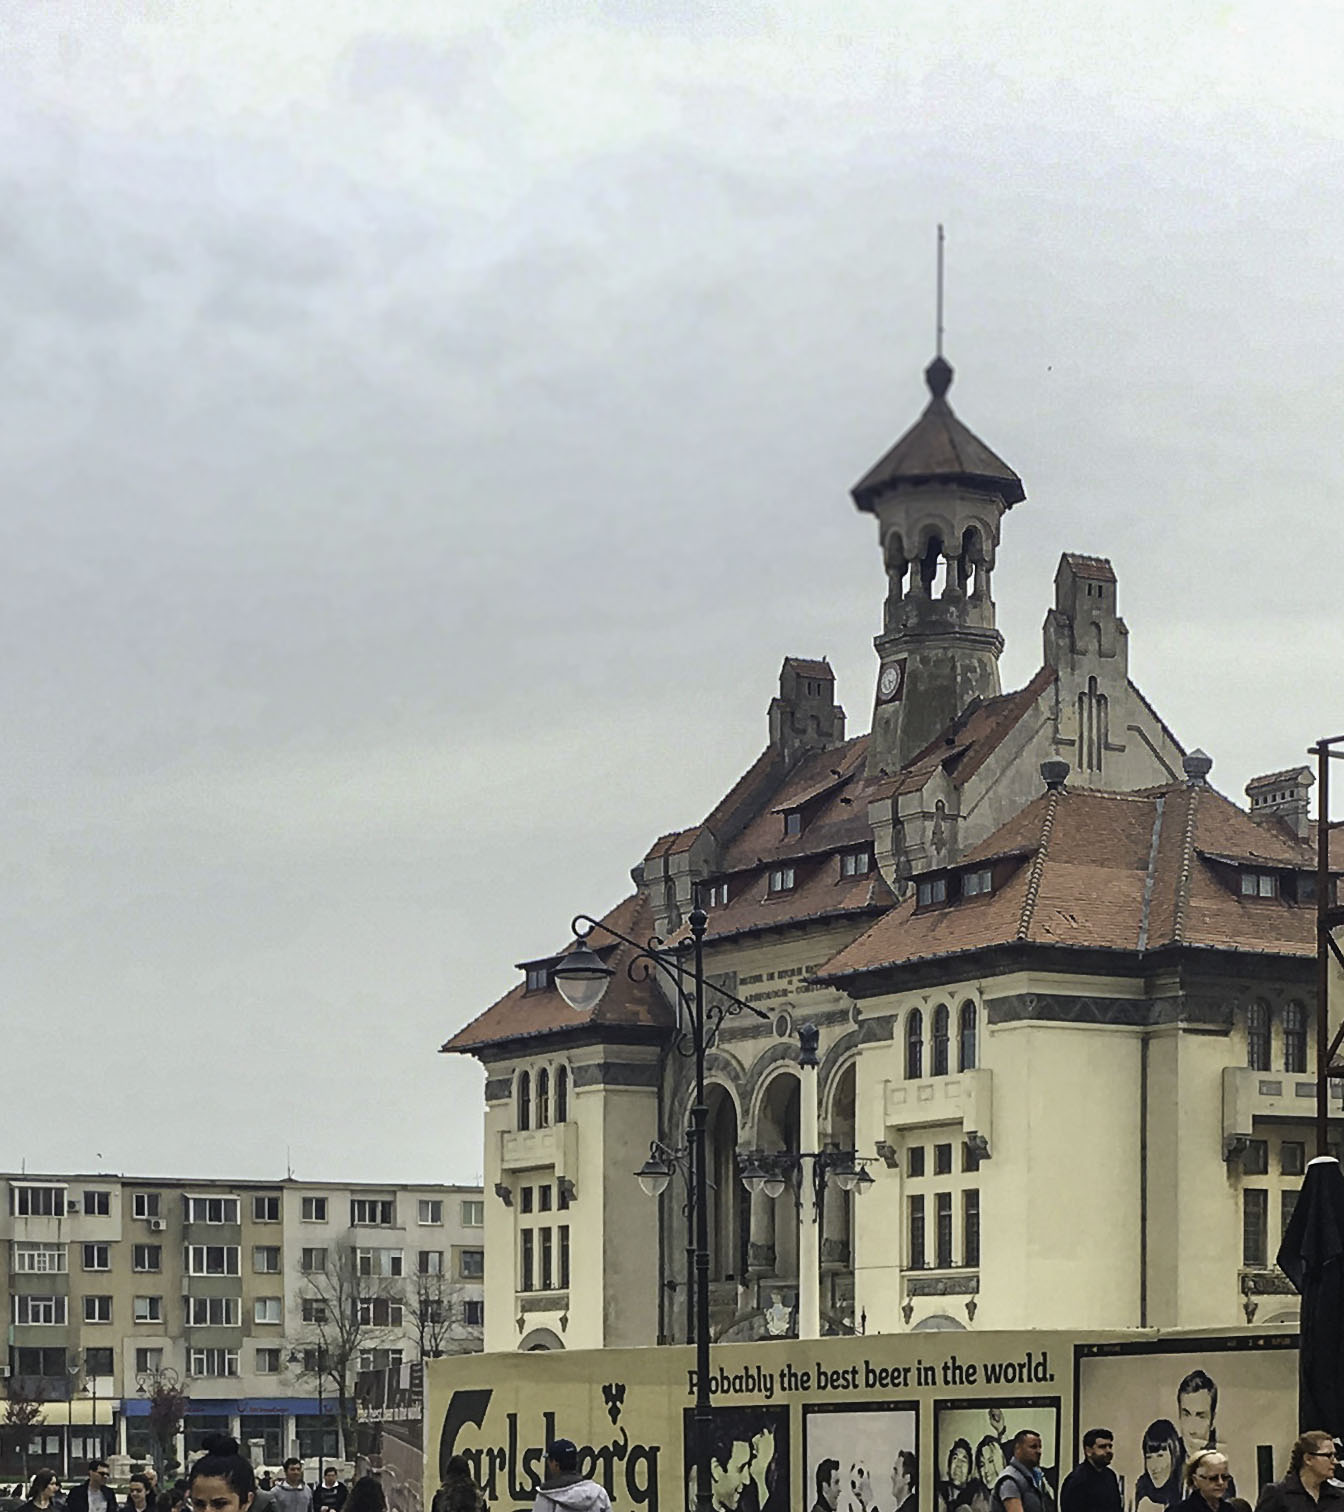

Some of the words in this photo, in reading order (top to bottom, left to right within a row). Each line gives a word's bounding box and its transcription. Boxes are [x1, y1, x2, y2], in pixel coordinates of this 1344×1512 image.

[688, 1366, 774, 1399] Pobably
[780, 1363, 811, 1392] the
[816, 1362, 859, 1390] best
[864, 1360, 911, 1388] beer
[917, 1359, 937, 1386] in
[942, 1356, 977, 1385] the
[983, 1351, 1055, 1384] world.
